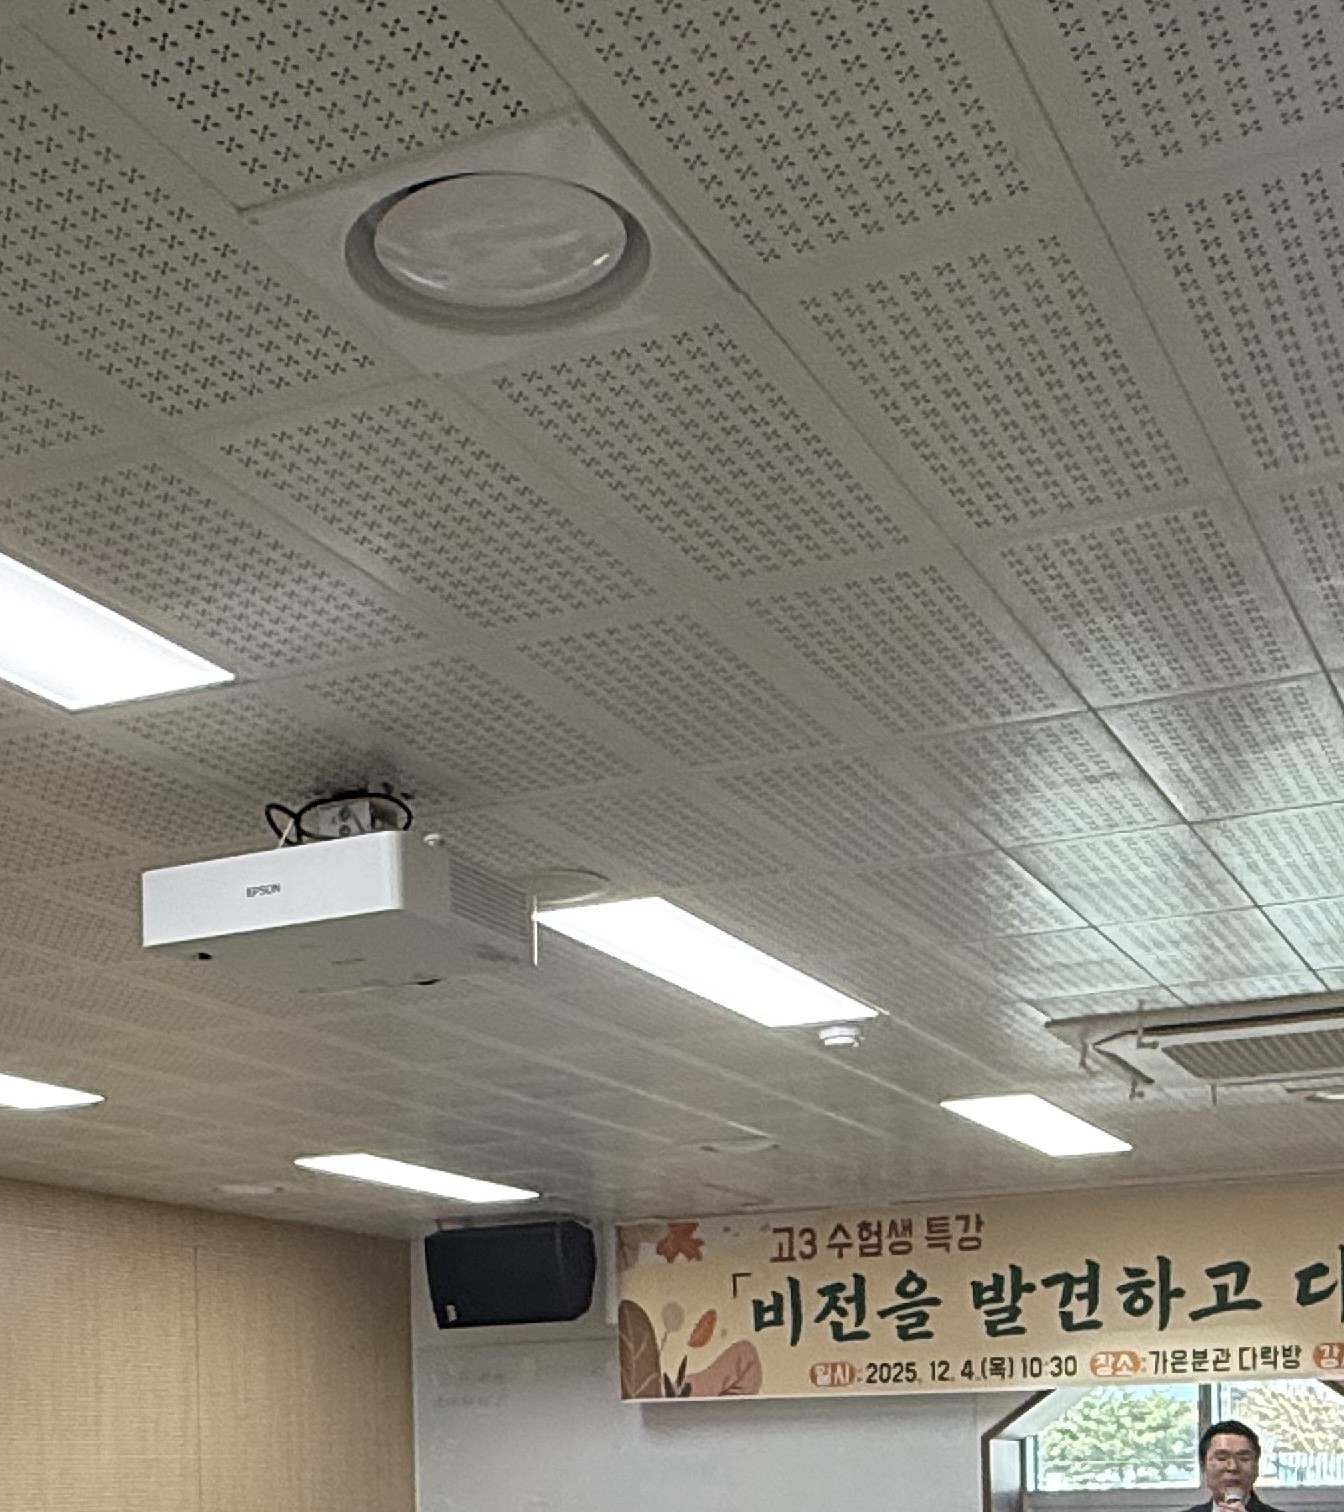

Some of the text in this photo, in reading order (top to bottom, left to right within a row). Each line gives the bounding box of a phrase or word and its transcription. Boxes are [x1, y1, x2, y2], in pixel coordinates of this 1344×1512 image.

[246, 883, 281, 898] EPSON
[768, 1213, 985, 1263] 고3 수험생 특강
[969, 1256, 1263, 1338] 발견하고
[1020, 1354, 1078, 1379] 10:30
[1148, 1348, 1232, 1375] 가은분관
[1238, 1344, 1303, 1371] 다락방
